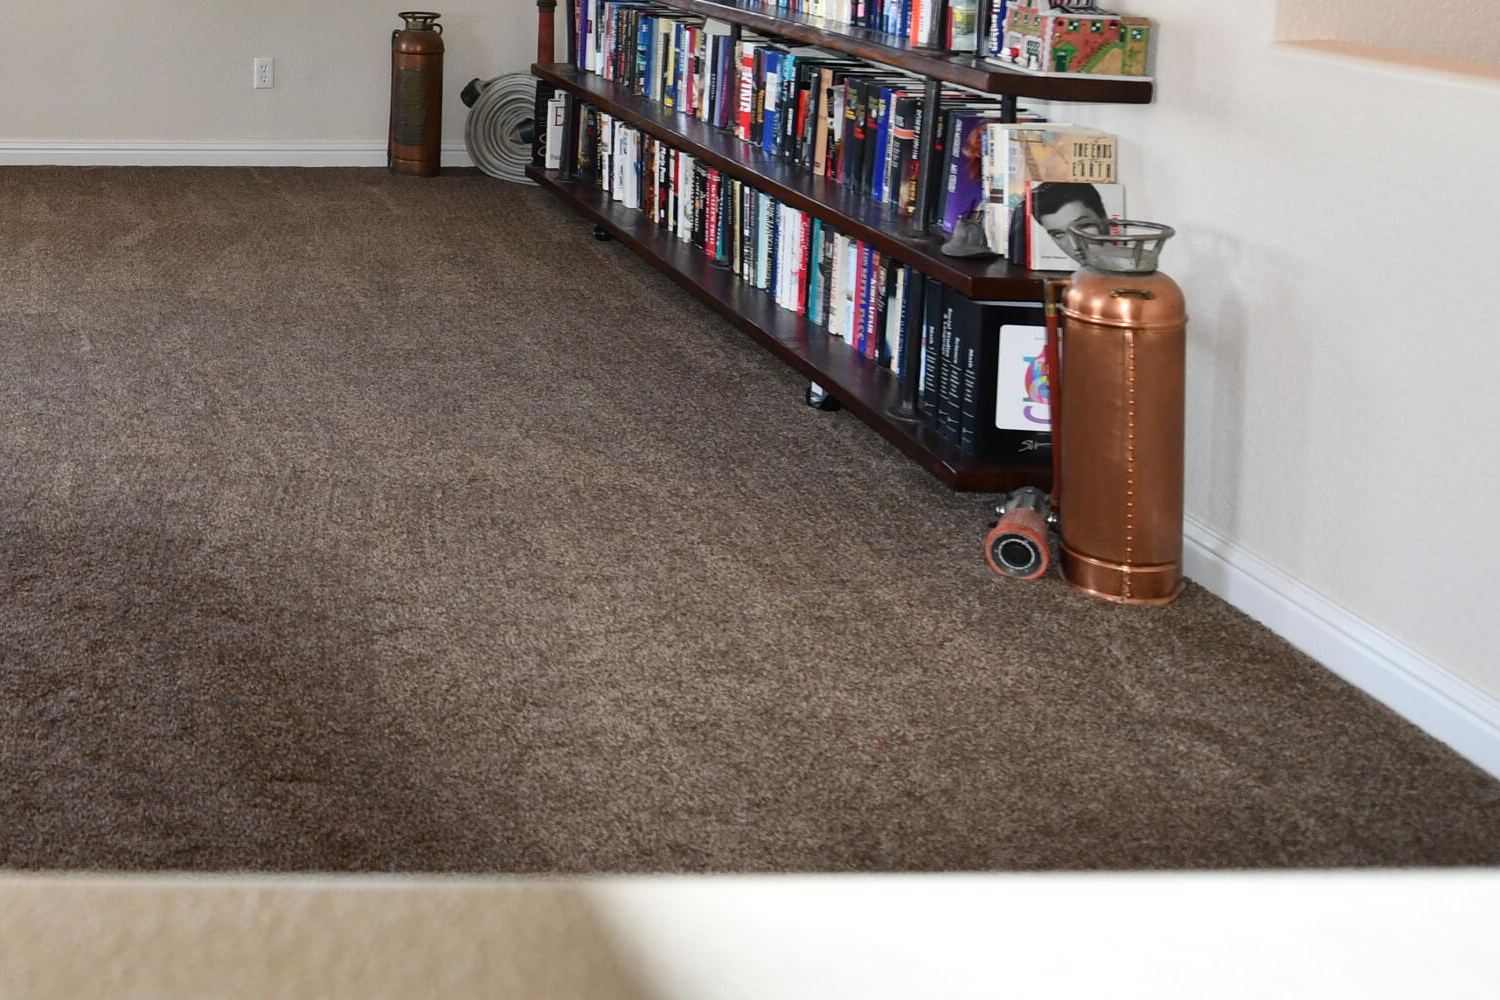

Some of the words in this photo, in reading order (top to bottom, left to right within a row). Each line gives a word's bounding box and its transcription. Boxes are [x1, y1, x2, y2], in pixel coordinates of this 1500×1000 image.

[740, 71, 753, 113] KING
[1073, 142, 1088, 158] THE
[1091, 143, 1112, 159] ENDS
[1072, 161, 1112, 179] EARTH
